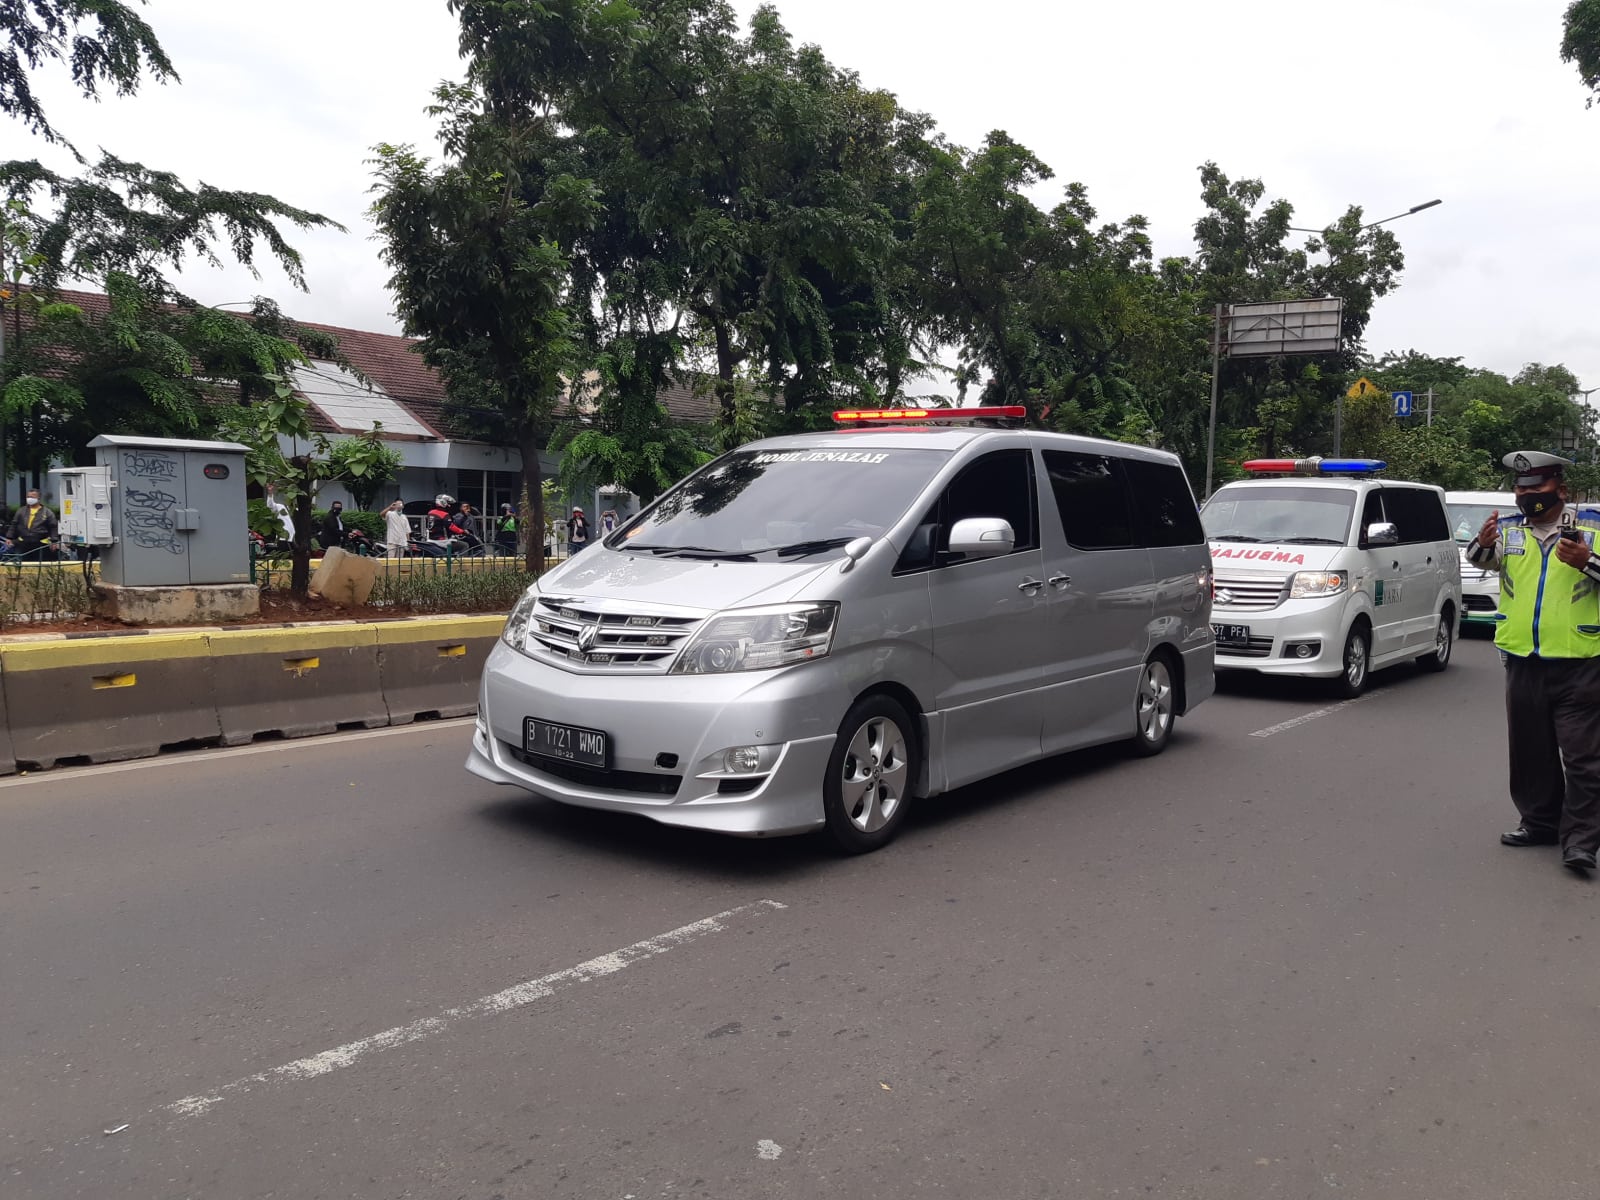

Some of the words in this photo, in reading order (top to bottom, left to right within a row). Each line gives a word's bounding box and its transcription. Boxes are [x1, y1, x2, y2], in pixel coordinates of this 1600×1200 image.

[751, 452, 801, 464] MOBIL
[801, 452, 889, 464] JENAZAH
[1211, 625, 1224, 636] 37
[1230, 626, 1247, 638] PFA
[529, 721, 535, 740] B
[545, 725, 571, 749] 1721
